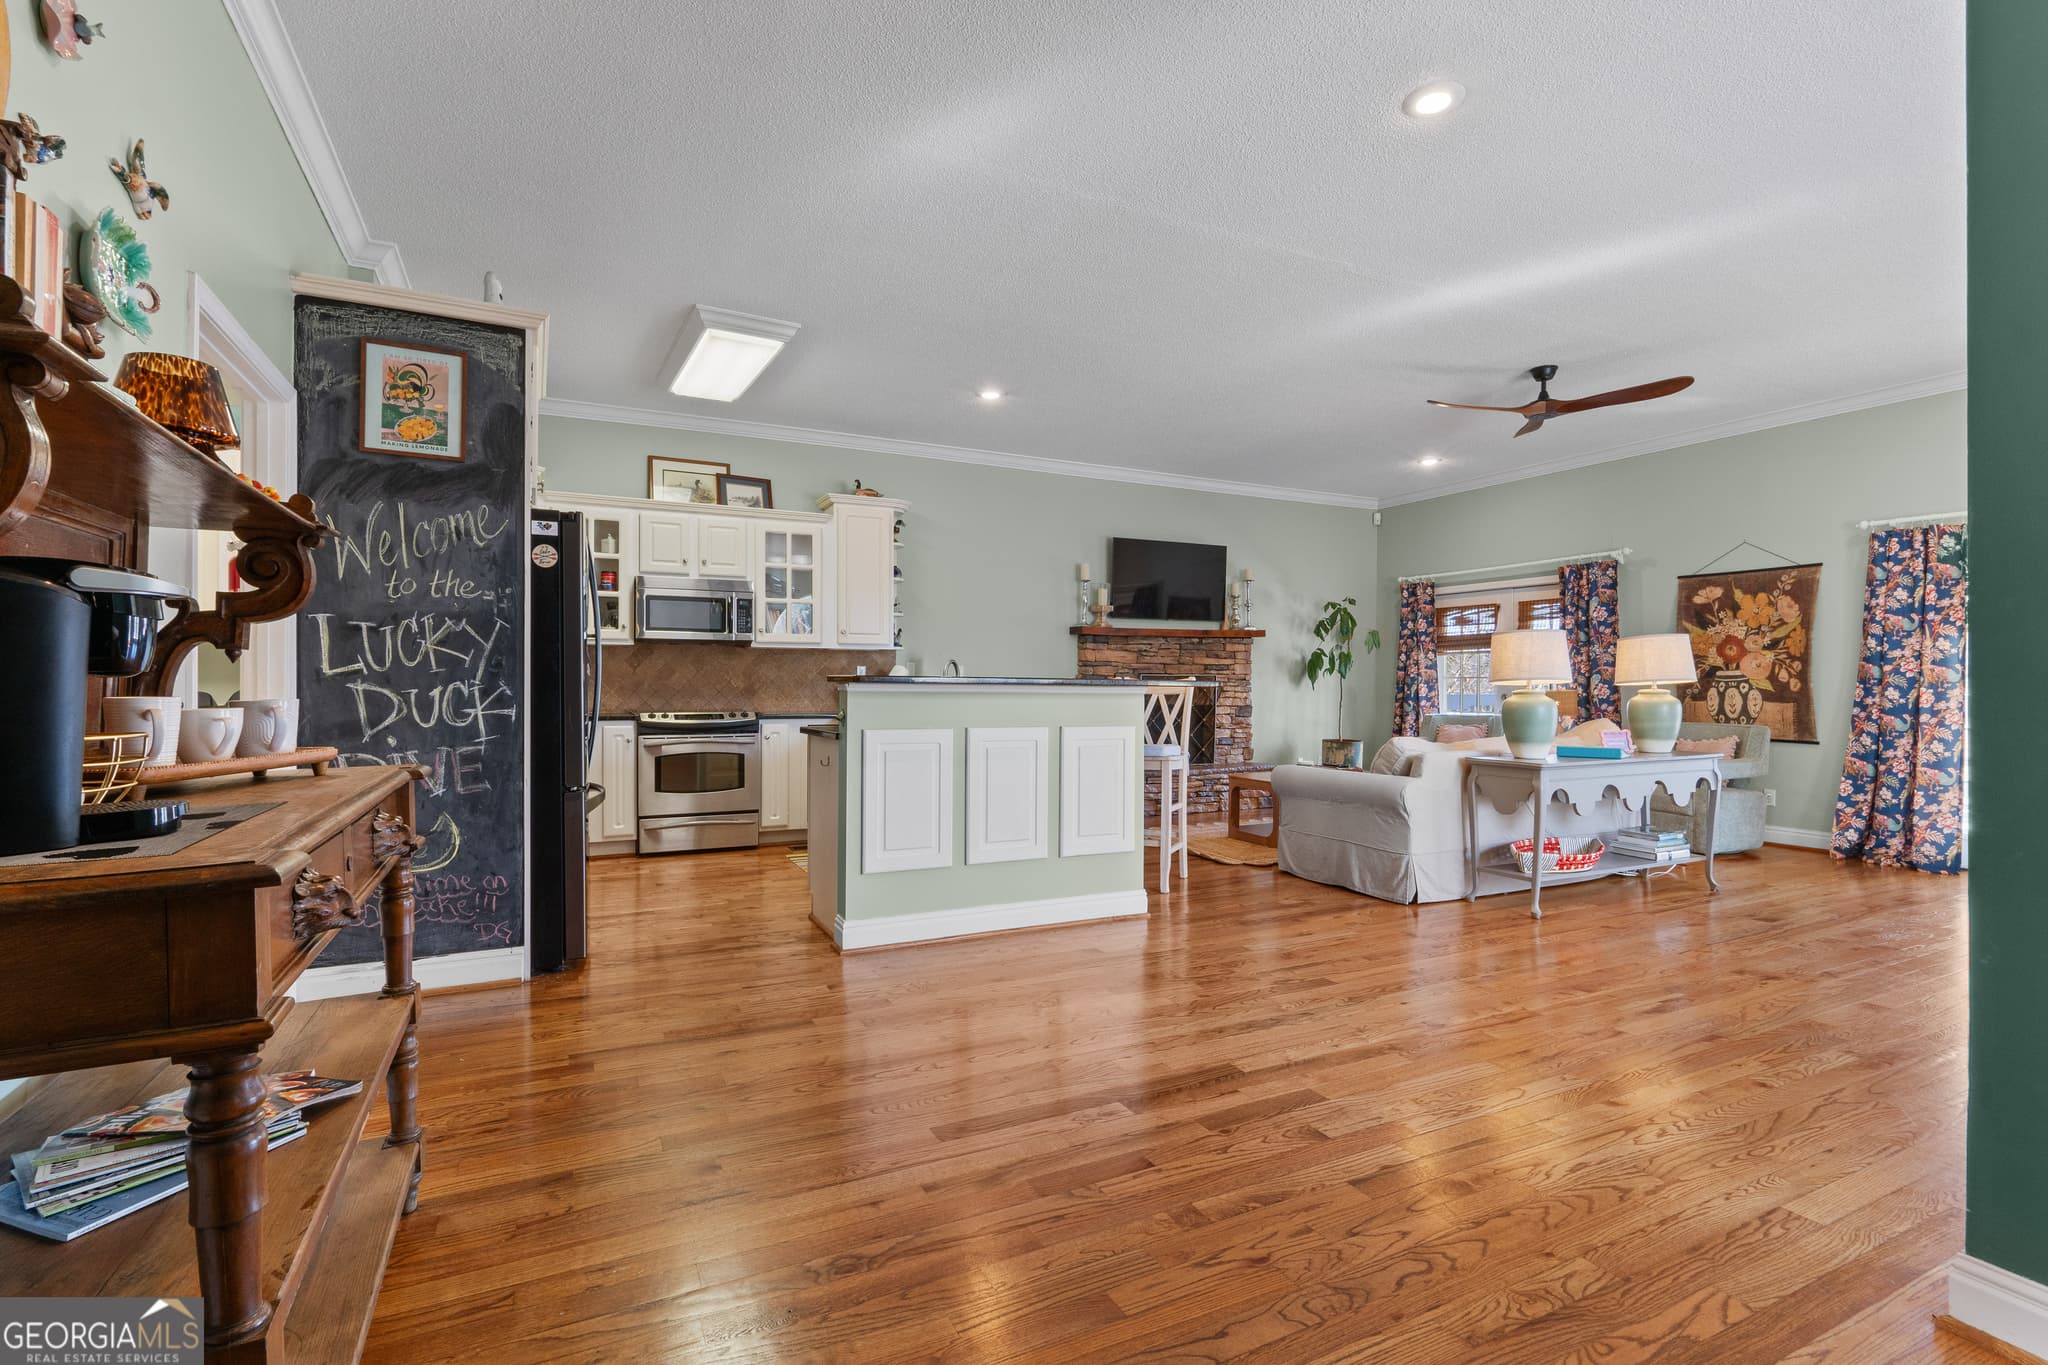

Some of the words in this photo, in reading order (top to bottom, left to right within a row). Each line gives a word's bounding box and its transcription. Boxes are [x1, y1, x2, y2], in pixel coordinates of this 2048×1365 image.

[326, 500, 509, 581] Welcome
[385, 570, 417, 599] to
[429, 569, 482, 599] the
[307, 611, 511, 684] LUCKY
[345, 680, 517, 743] DUCK
[335, 745, 493, 798] VE
